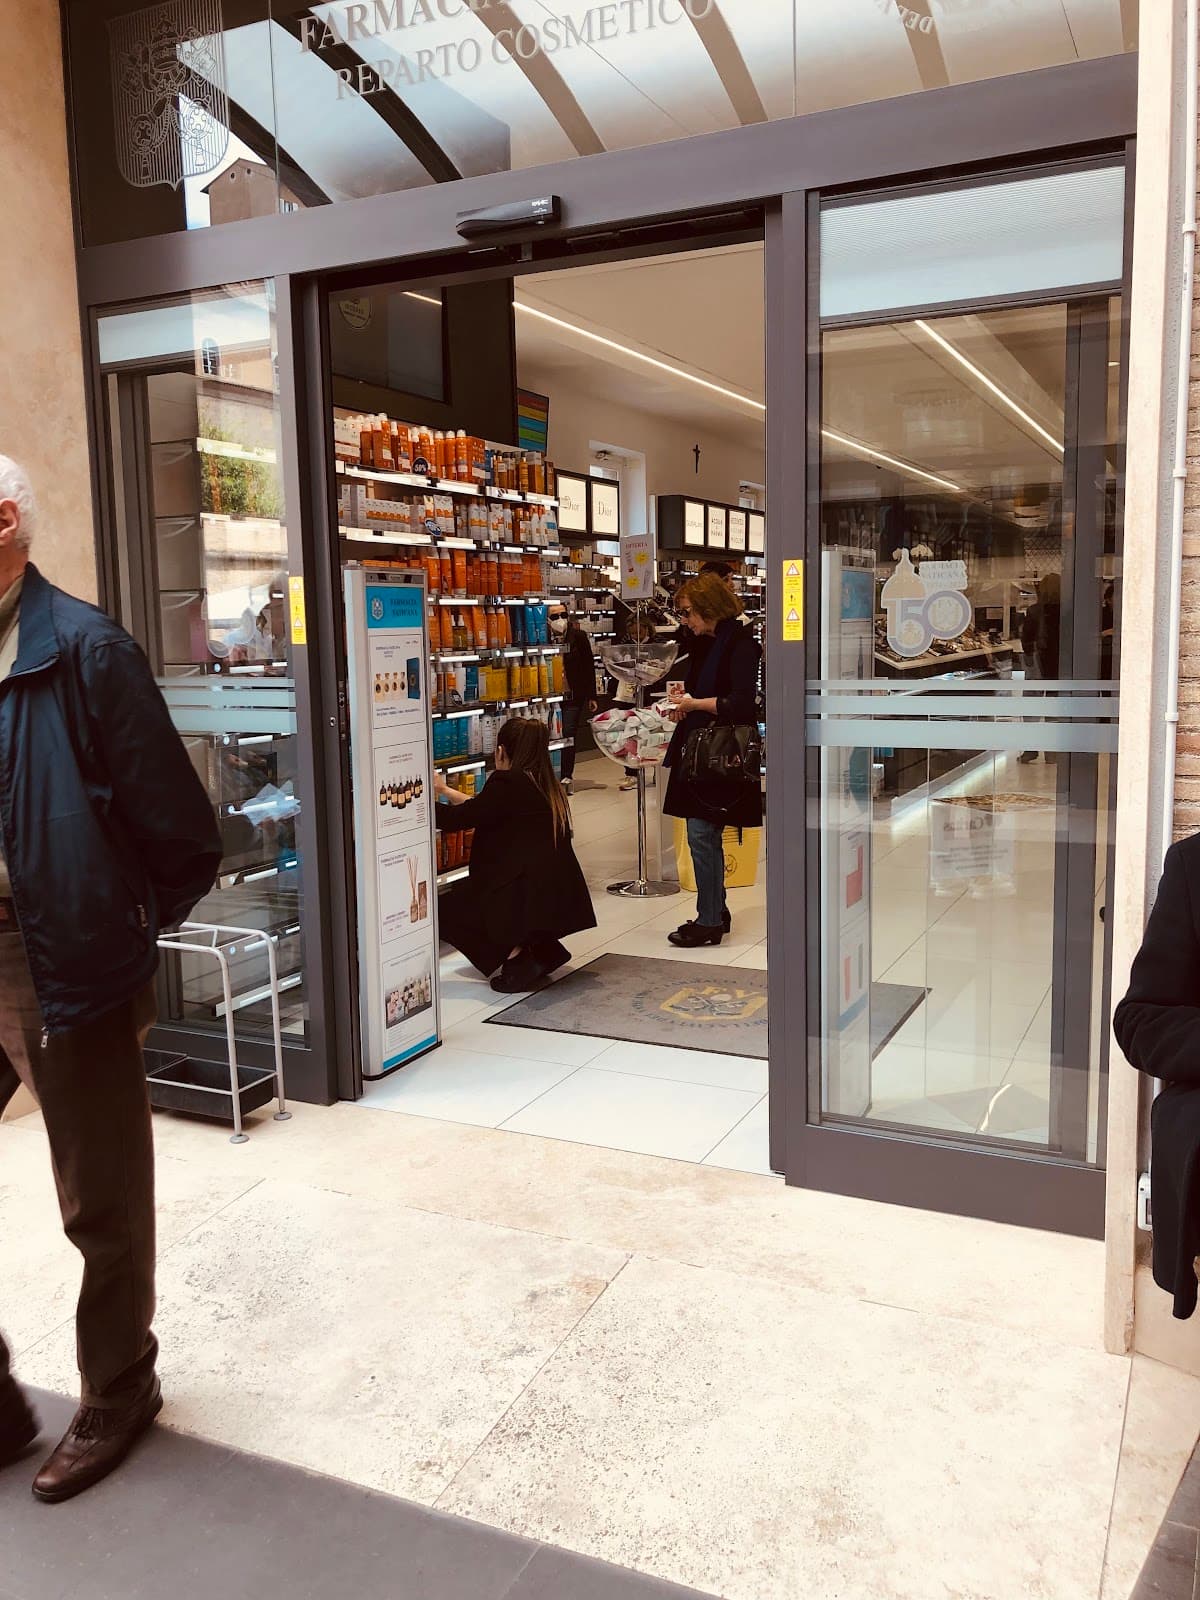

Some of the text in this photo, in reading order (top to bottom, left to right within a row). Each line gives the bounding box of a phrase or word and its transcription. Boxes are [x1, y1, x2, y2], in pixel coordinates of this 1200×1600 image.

[297, 0, 506, 54] FARMAC
[335, 0, 712, 101] REPARTO COSMETICO
[598, 500, 612, 517] Dior
